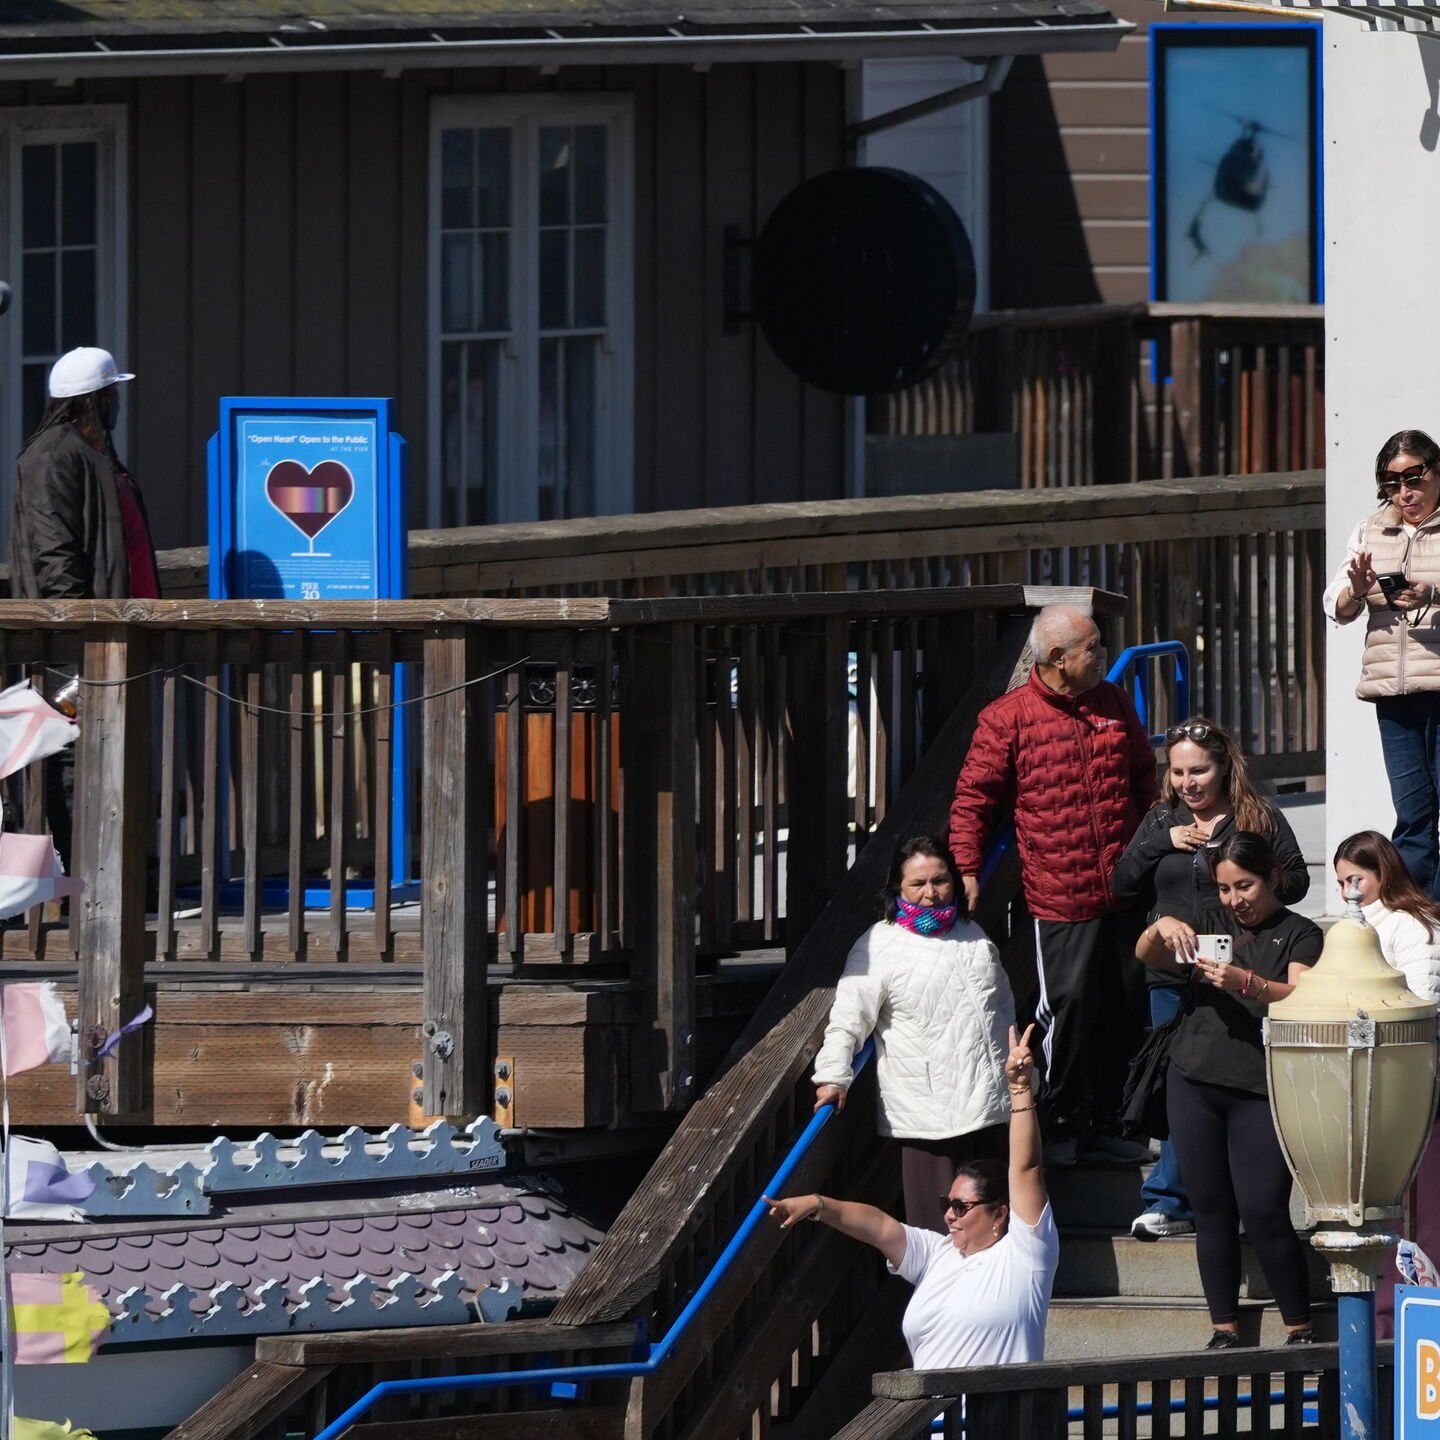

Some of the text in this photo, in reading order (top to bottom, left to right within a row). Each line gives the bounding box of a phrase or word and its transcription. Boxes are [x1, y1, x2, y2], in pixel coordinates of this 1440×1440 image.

[299, 435, 322, 445] Open
[322, 436, 331, 444] to
[332, 436, 344, 444] the
[345, 436, 369, 444] Public
